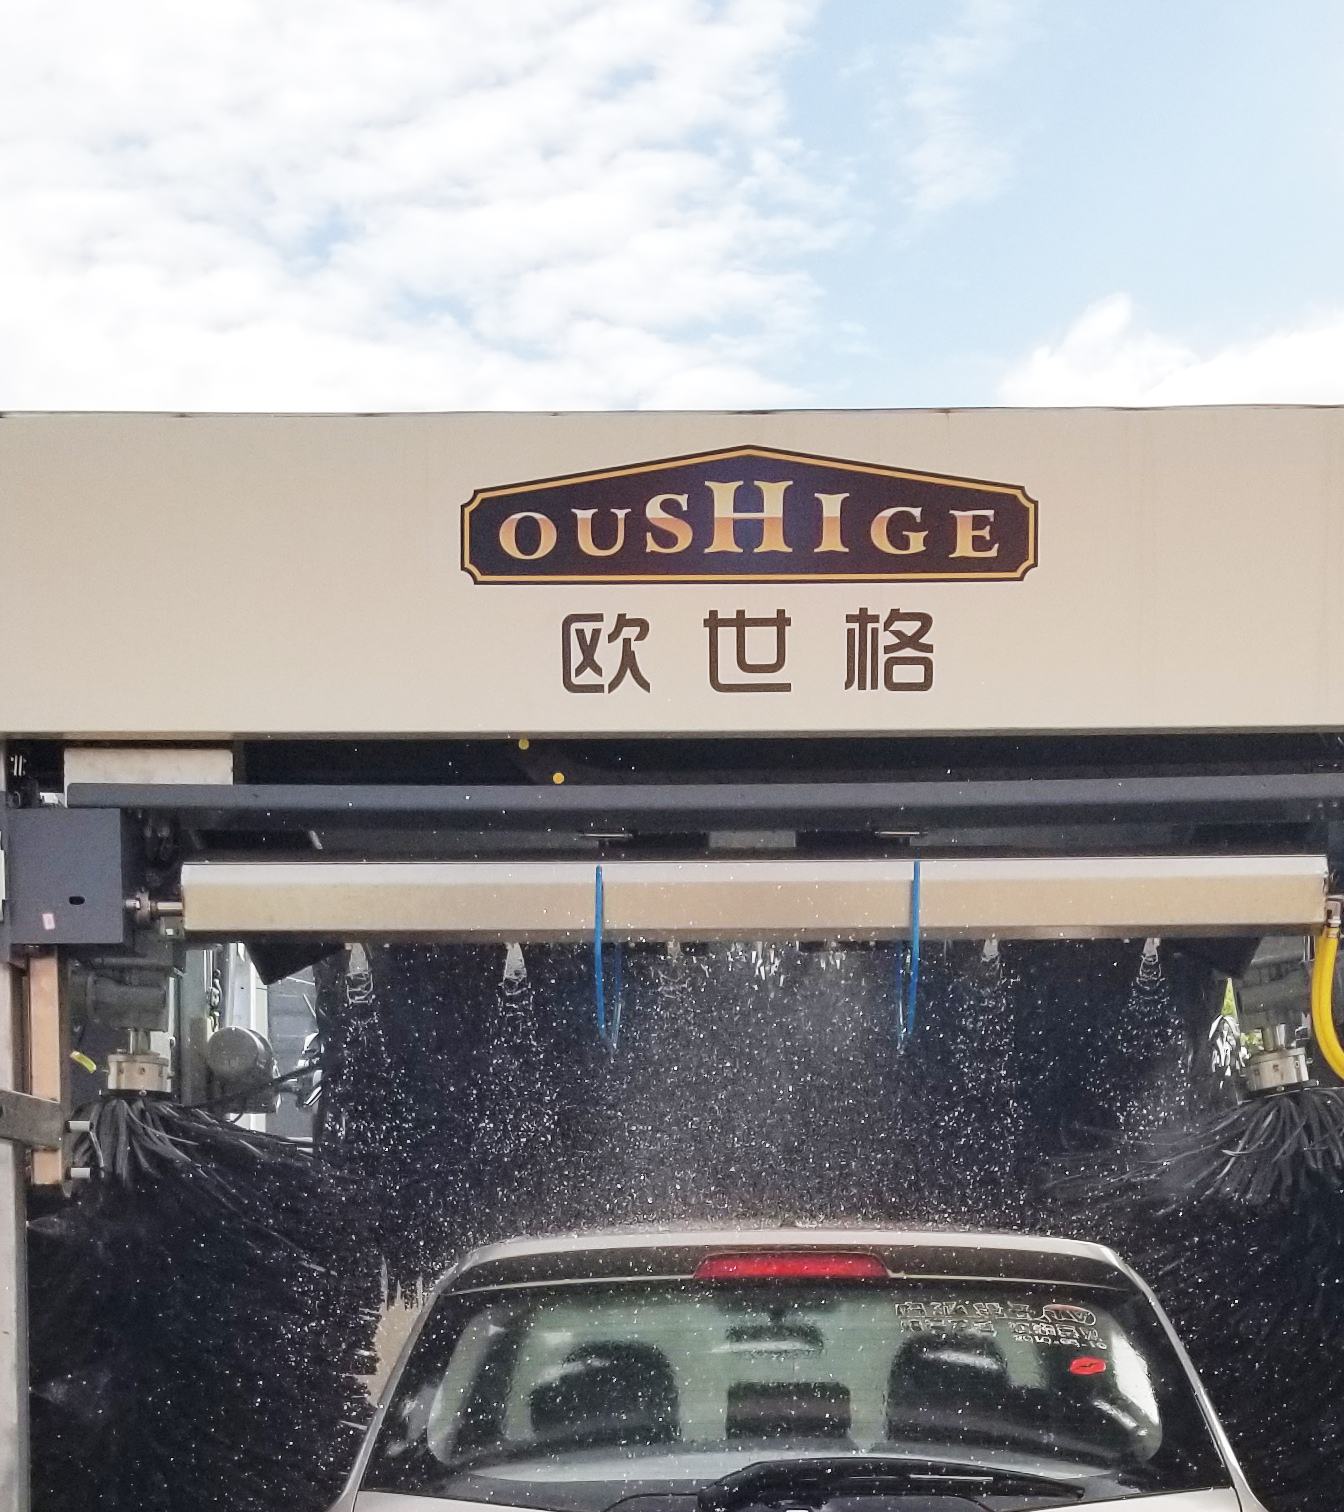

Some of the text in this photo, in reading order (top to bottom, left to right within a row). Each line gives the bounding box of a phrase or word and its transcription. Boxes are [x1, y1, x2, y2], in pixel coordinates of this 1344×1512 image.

[499, 480, 1000, 560] OUSHIGE
[561, 607, 936, 694] 欧世格
